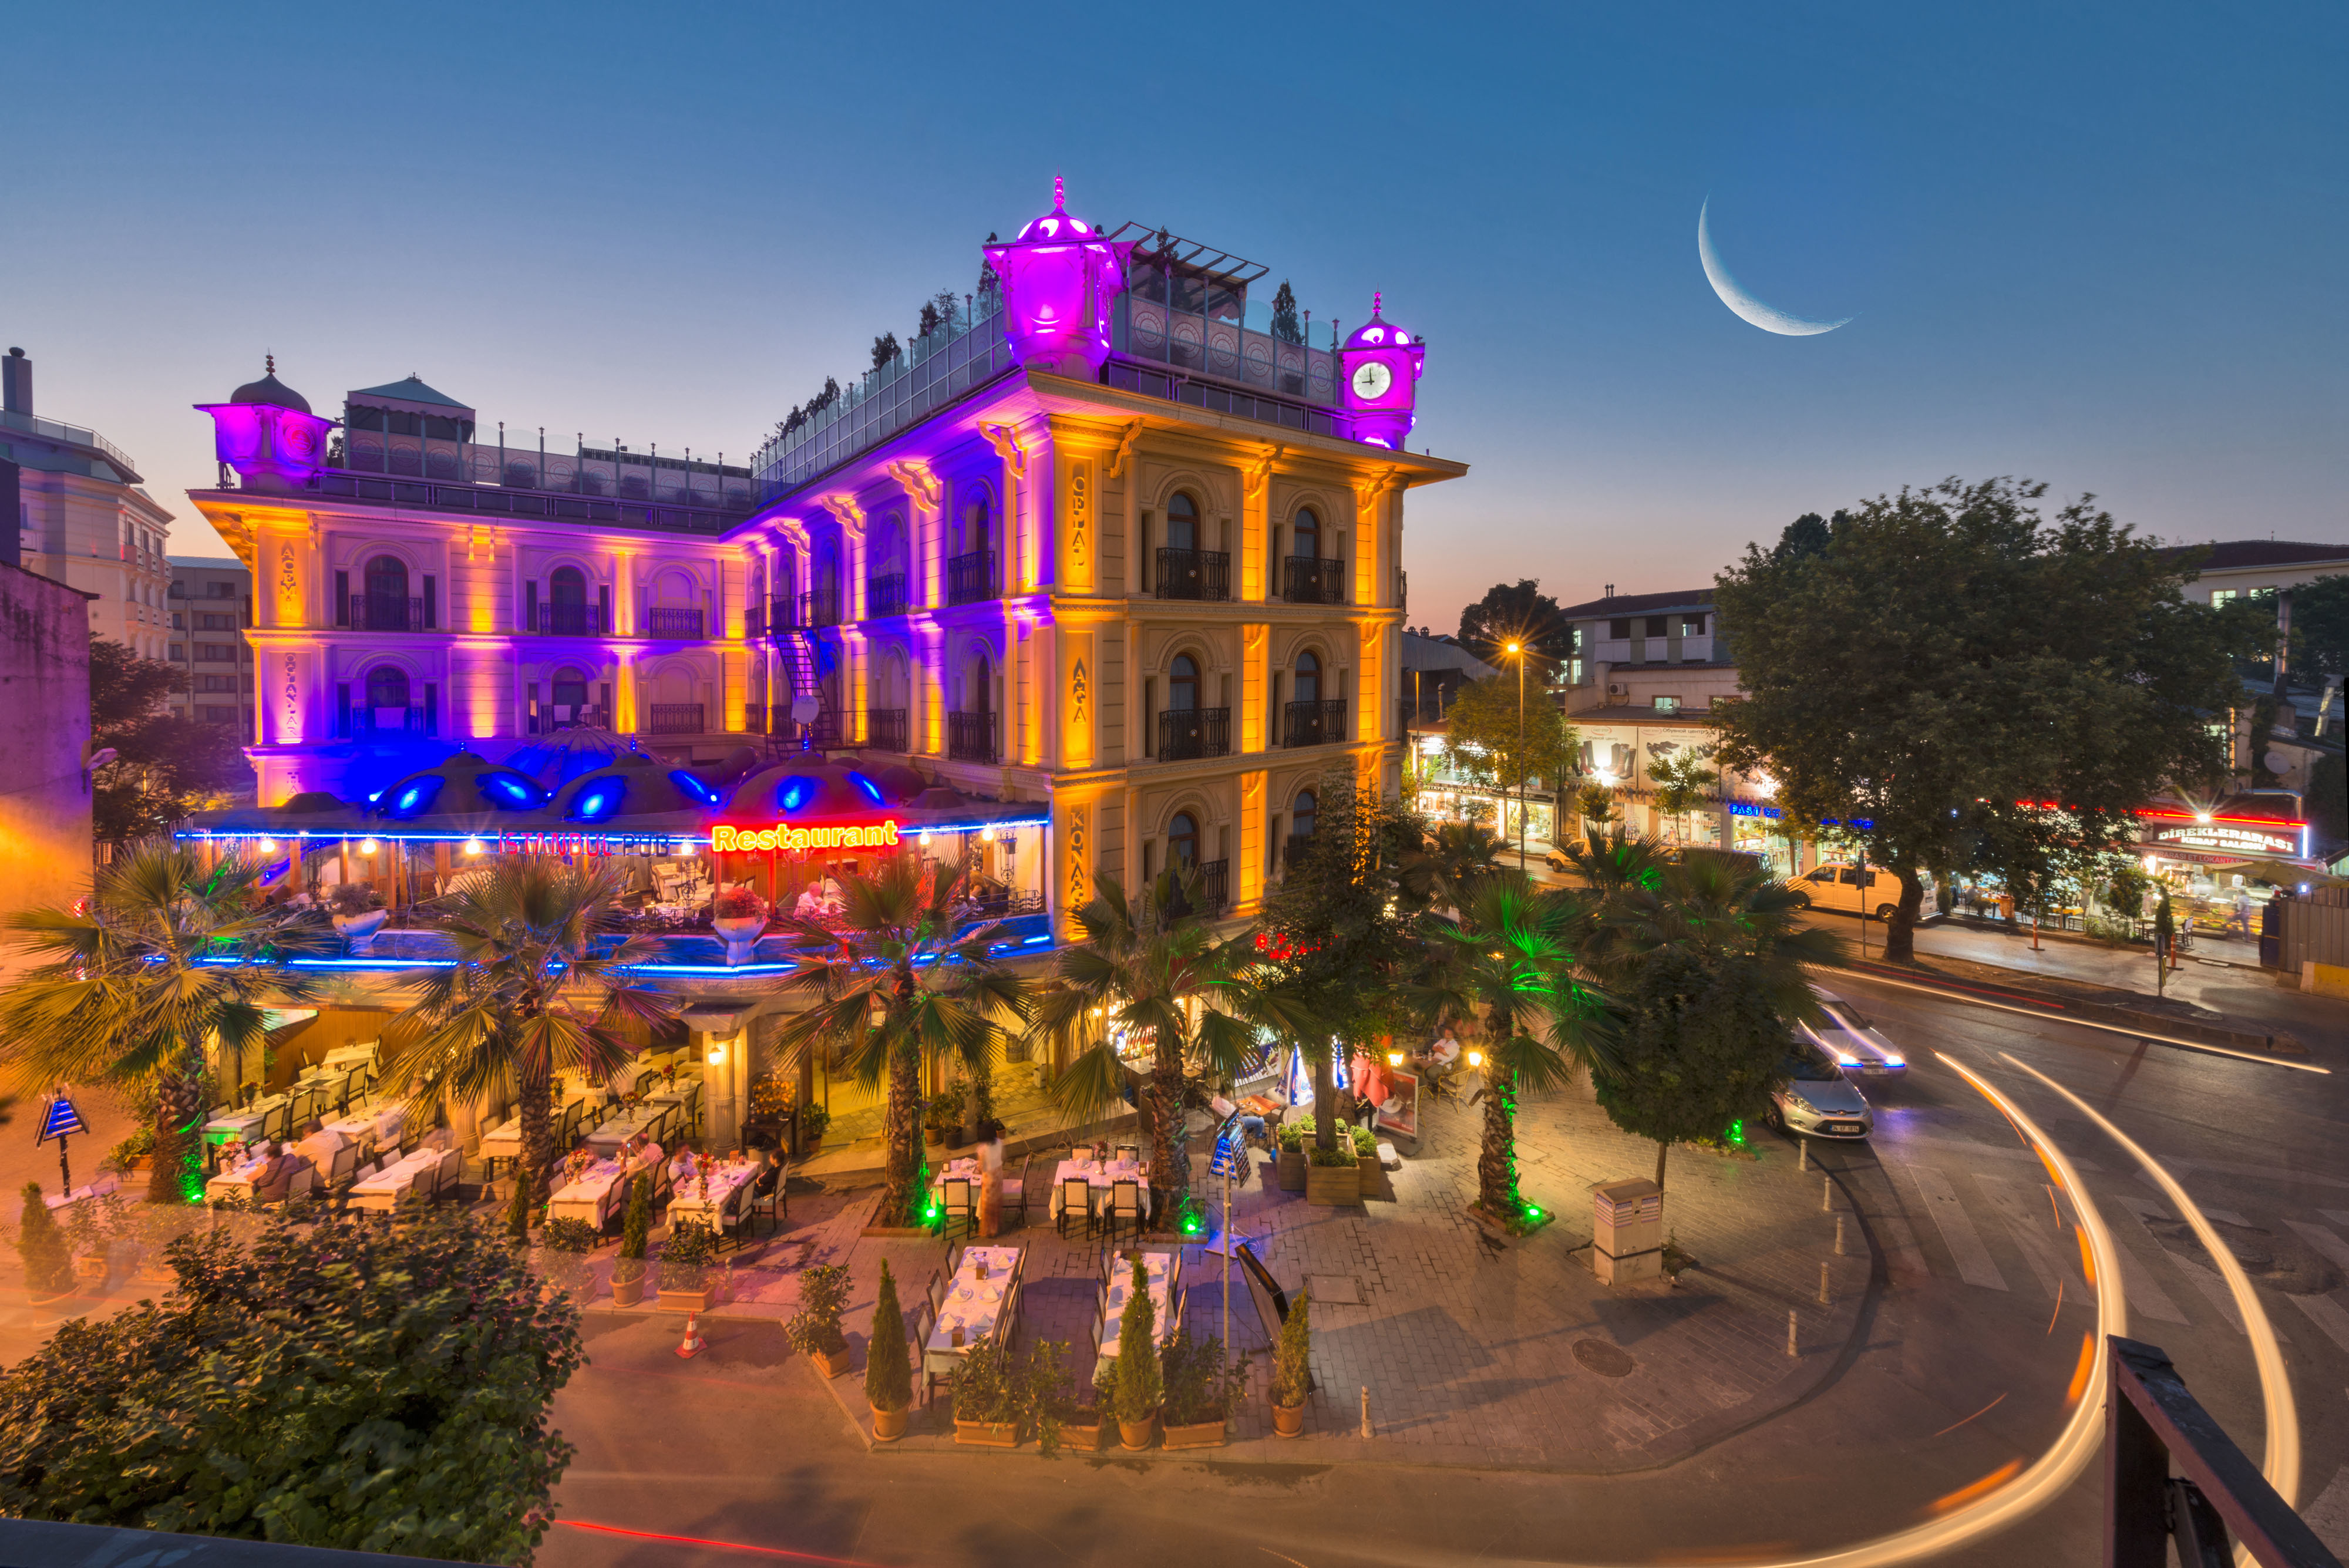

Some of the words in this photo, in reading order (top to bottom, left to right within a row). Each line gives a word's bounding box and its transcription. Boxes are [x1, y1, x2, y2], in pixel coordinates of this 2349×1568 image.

[1072, 668, 1086, 725] AĞA
[286, 772, 301, 801] HA
[1730, 804, 1760, 817] FAST
[498, 828, 612, 857] İSTANBUL
[622, 833, 670, 857] PUB
[711, 820, 898, 852] Restaurant
[2158, 827, 2294, 852] DİREKLERARASI
[2181, 836, 2218, 846] KEBAP
[2219, 839, 2267, 851] SALONU
